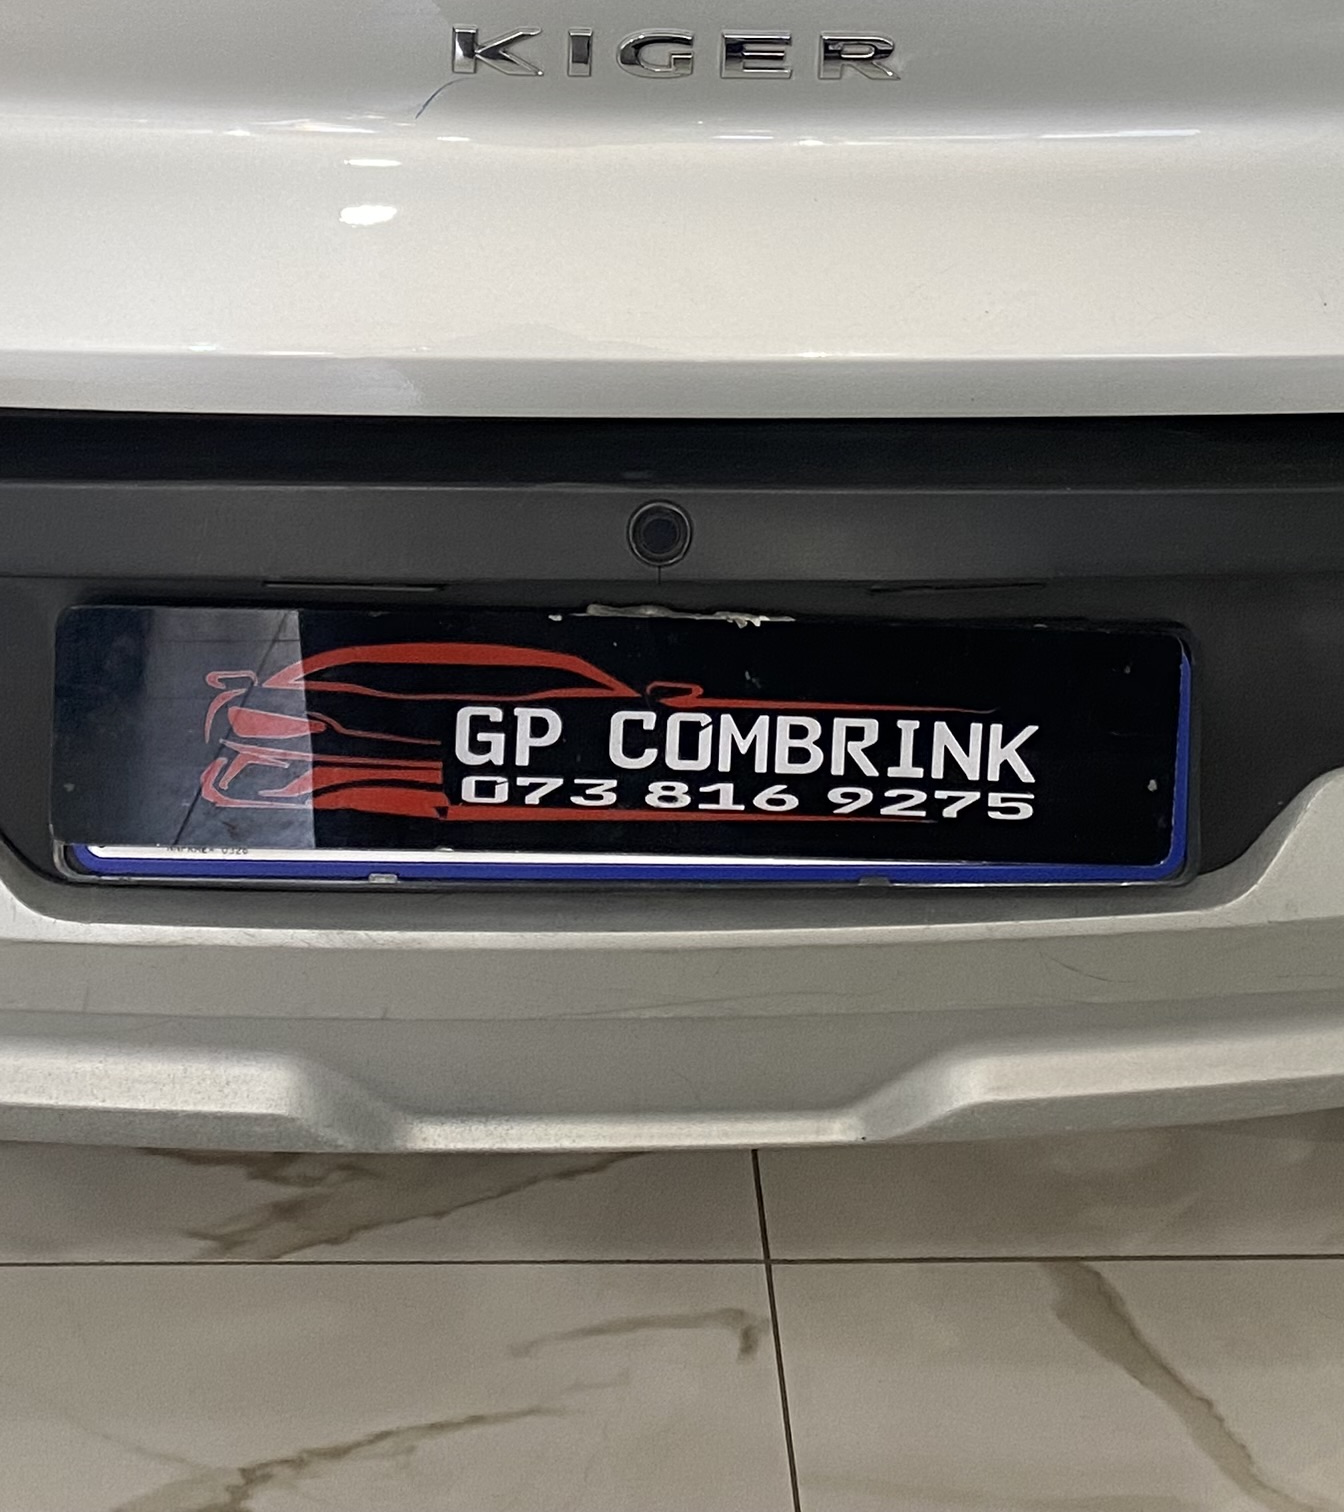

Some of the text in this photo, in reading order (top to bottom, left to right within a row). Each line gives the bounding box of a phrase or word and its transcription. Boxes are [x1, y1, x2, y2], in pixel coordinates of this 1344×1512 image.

[452, 24, 902, 80] KIGER
[454, 706, 1040, 784] GP COMBRINK
[460, 775, 1035, 821] 073 816 9275
